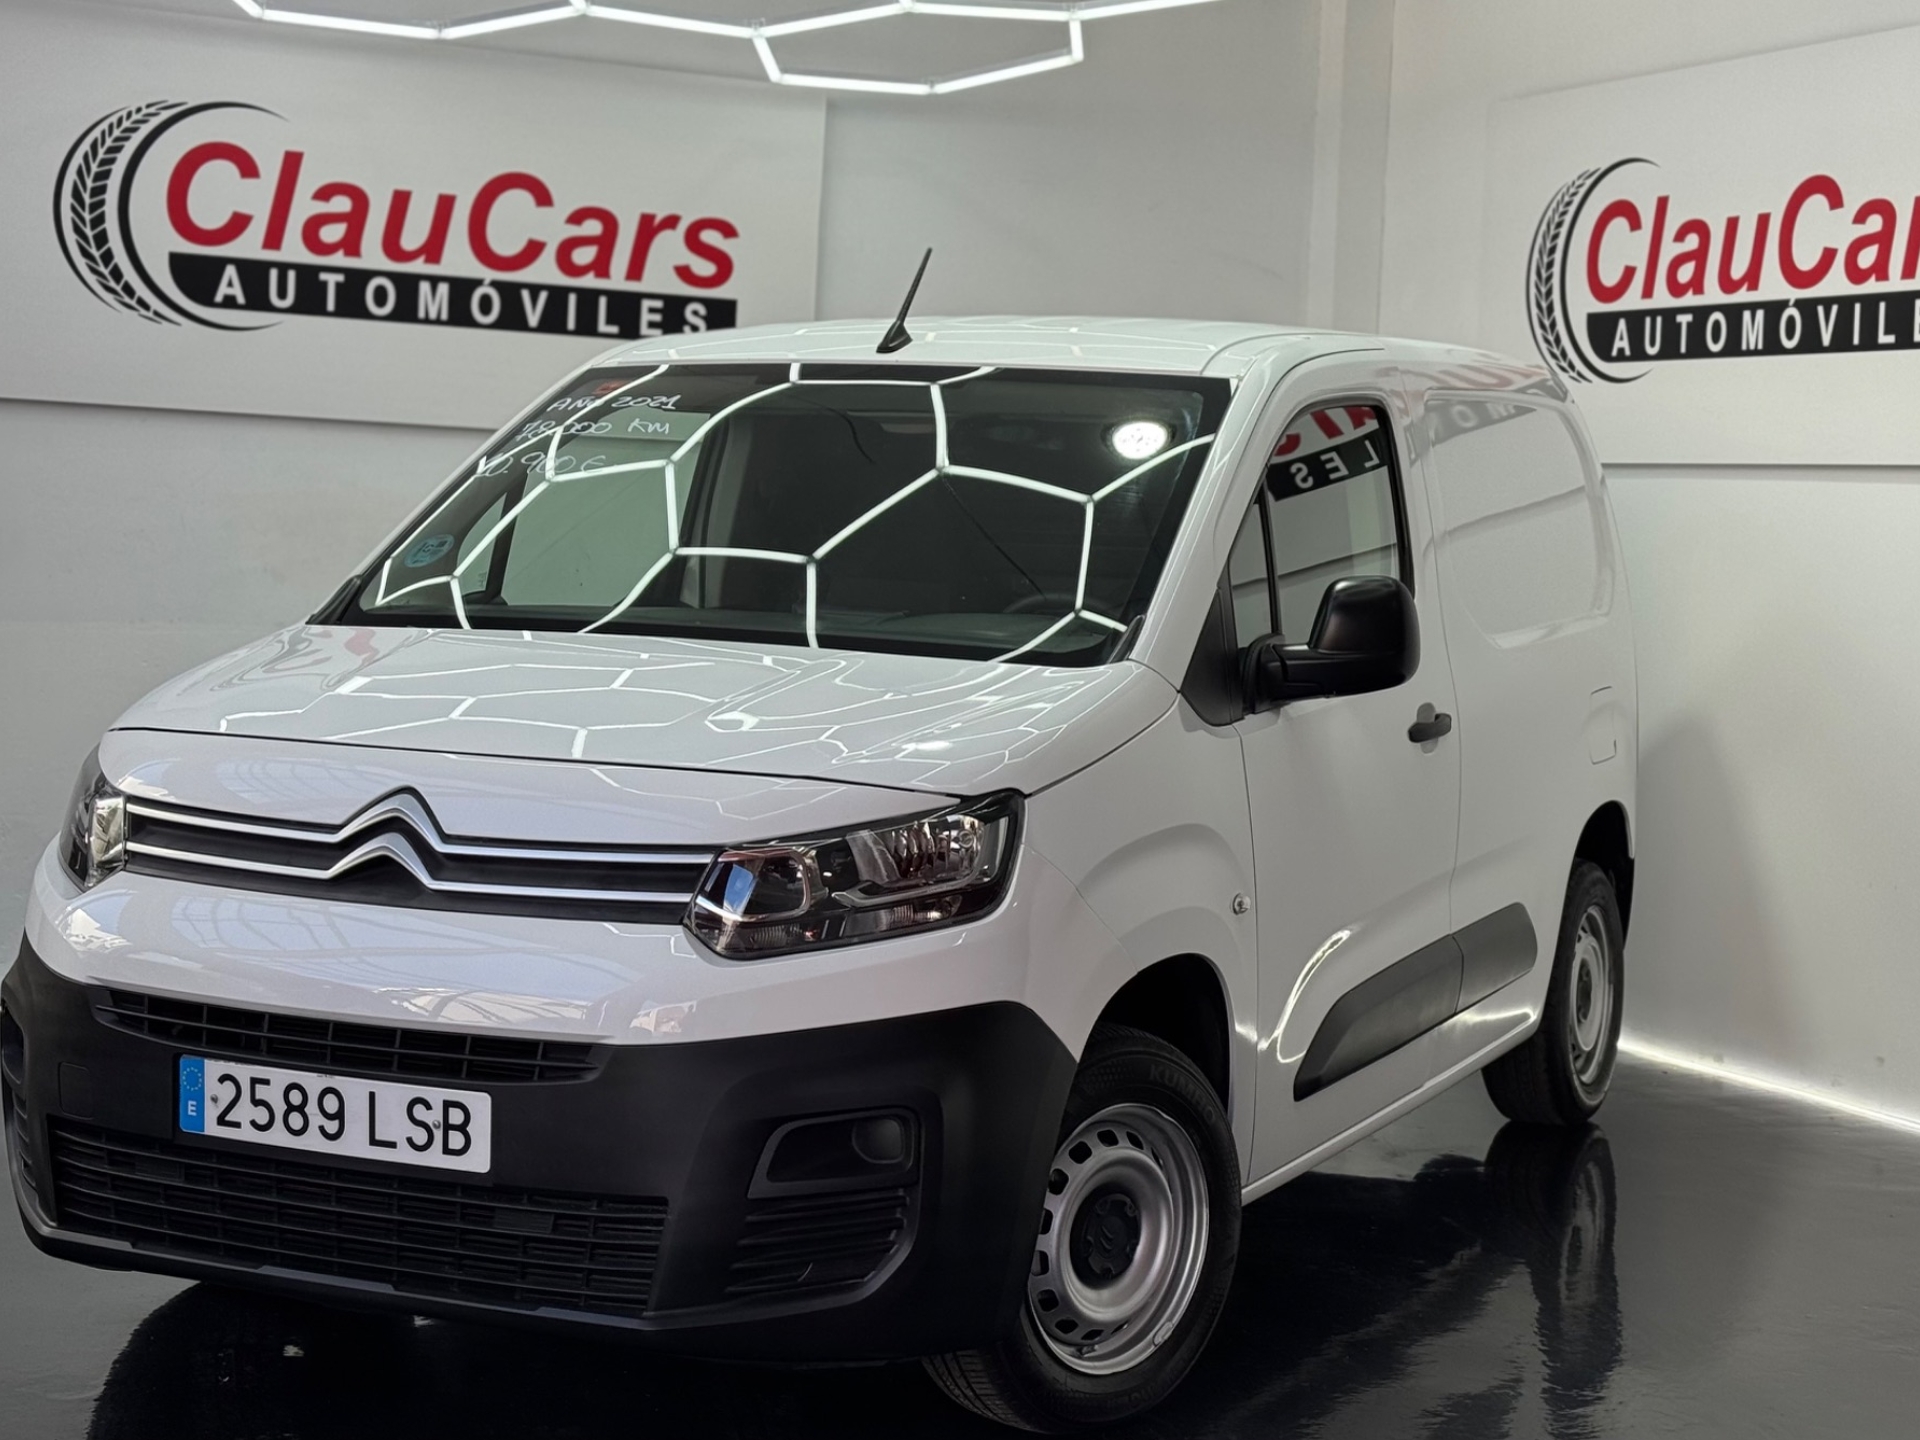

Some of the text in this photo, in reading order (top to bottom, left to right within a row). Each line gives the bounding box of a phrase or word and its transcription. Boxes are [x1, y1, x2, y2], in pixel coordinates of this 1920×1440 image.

[166, 142, 739, 289] ClauCars
[215, 264, 707, 335] AUTOMÓVILES
[611, 394, 681, 410] 2021
[188, 1101, 197, 1116] E
[216, 1073, 472, 1157] 2589 LSB
